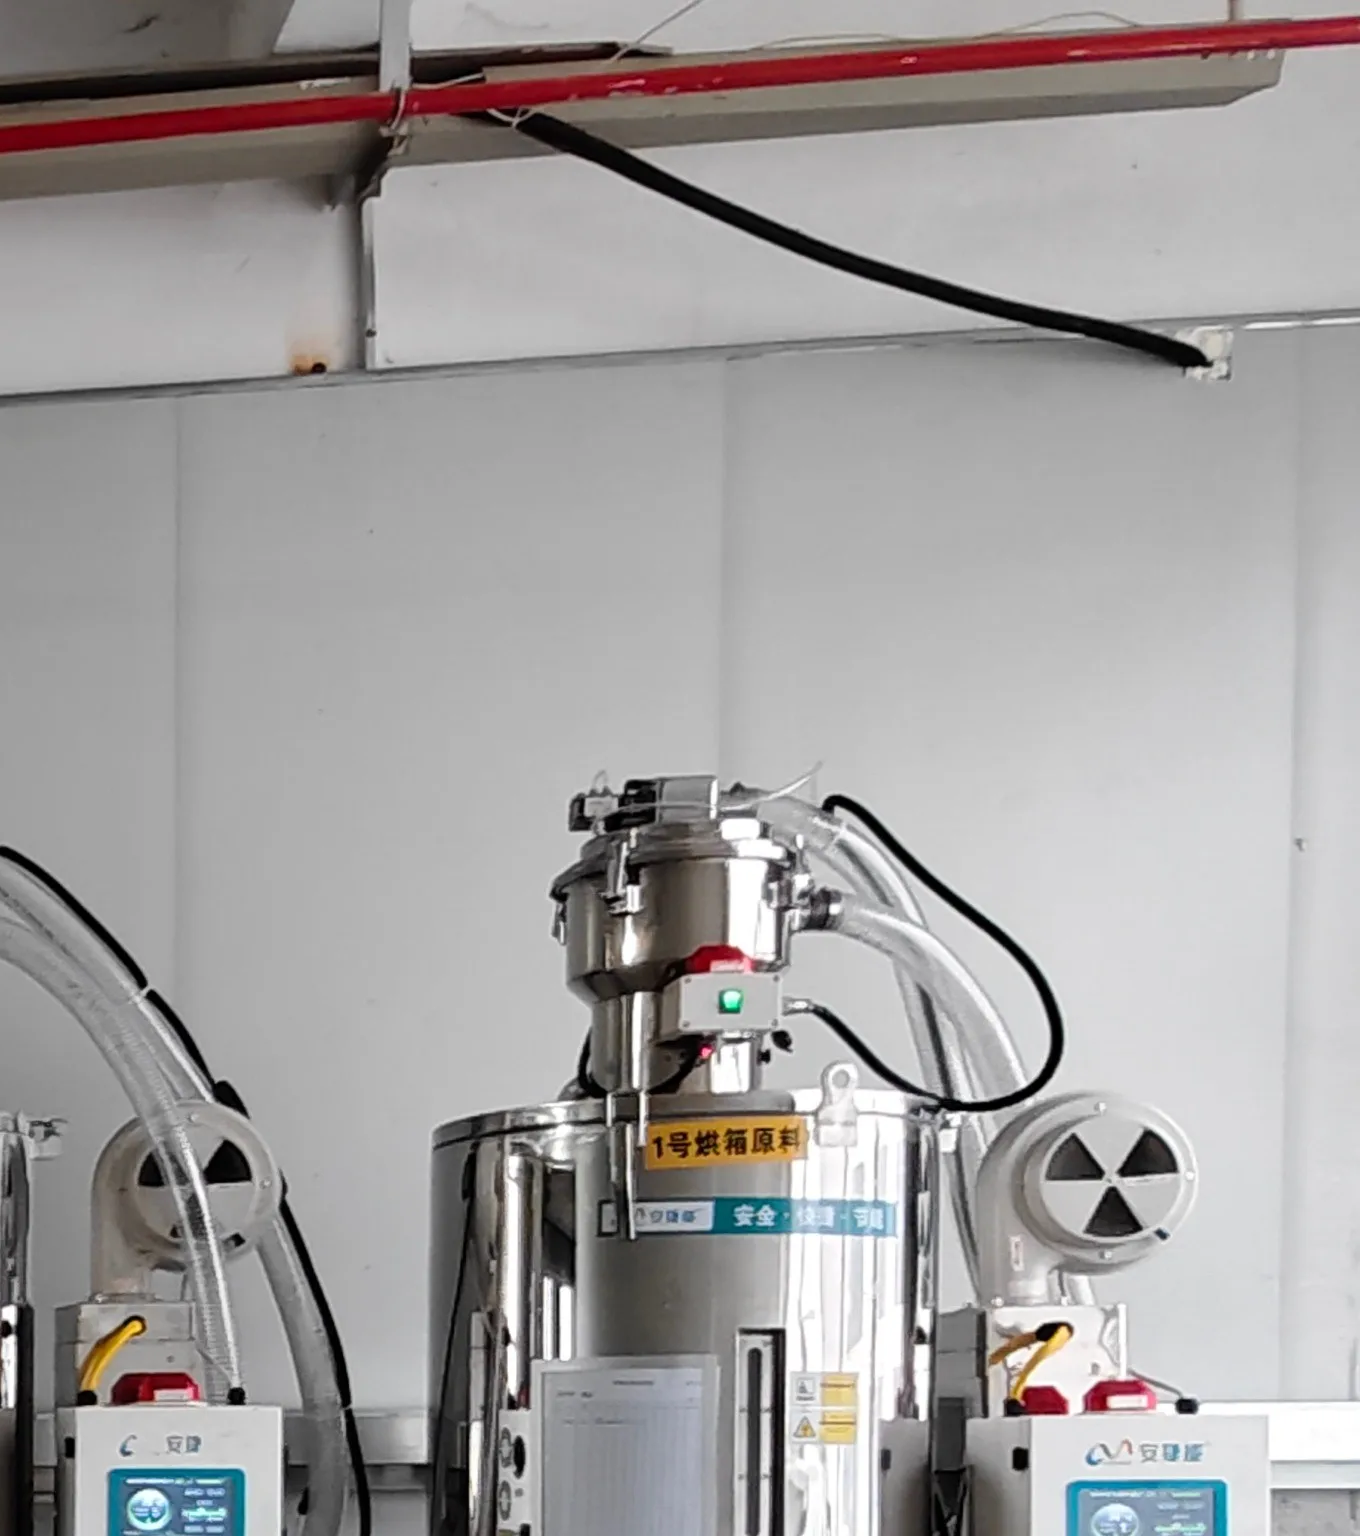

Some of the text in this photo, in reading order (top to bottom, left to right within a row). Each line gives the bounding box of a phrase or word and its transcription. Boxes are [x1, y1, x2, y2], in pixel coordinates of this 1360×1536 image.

[652, 1125, 801, 1159] 1号烘箱原料
